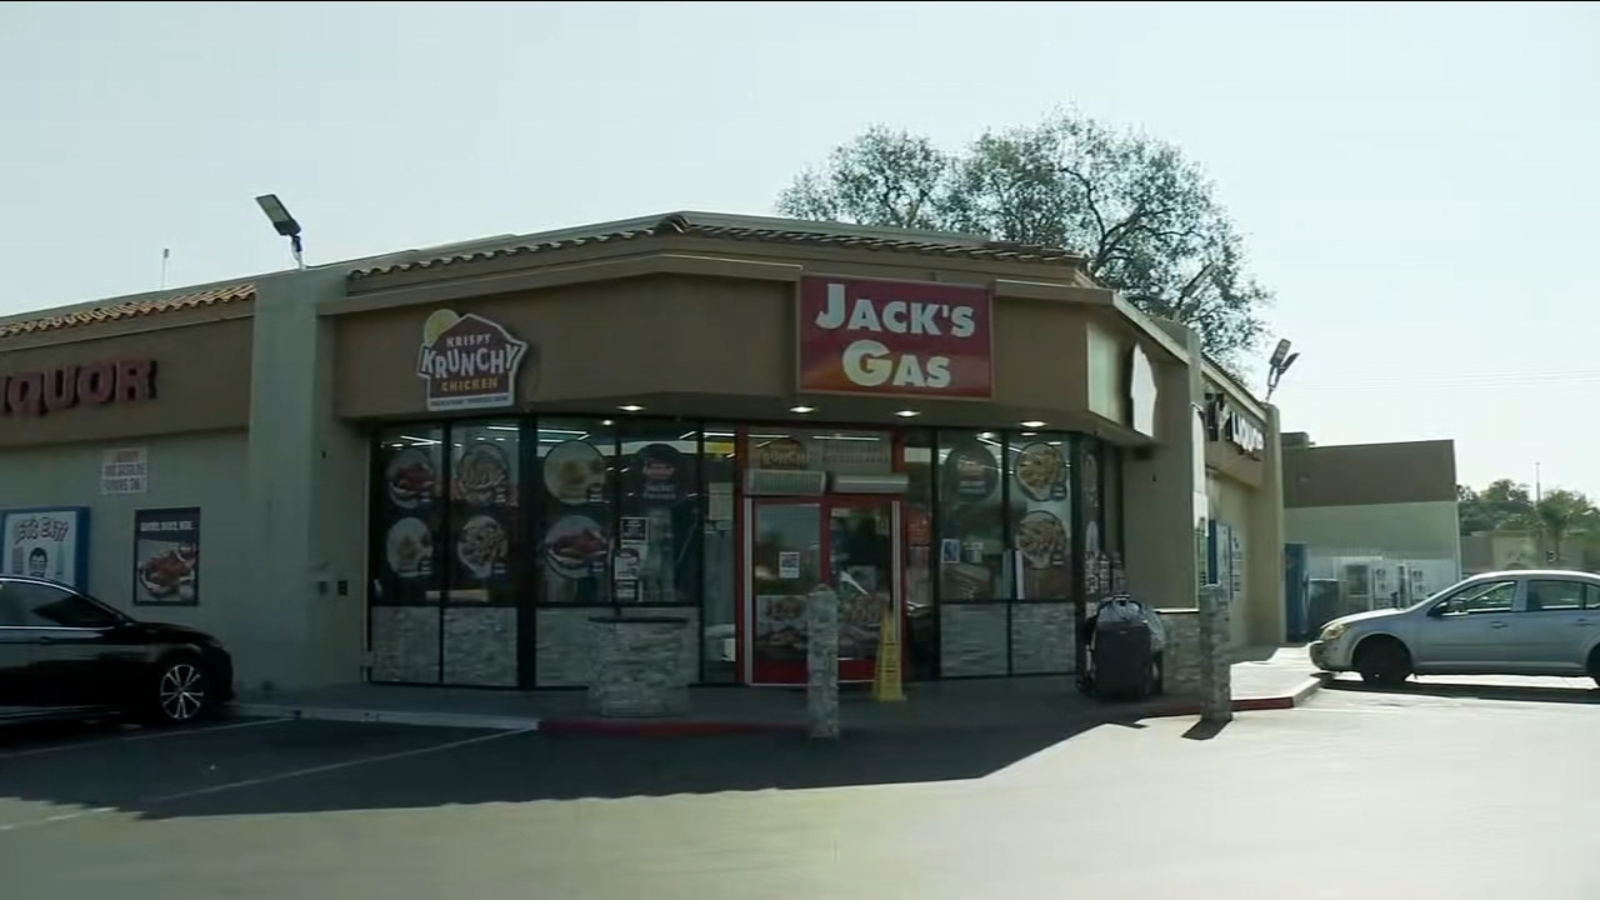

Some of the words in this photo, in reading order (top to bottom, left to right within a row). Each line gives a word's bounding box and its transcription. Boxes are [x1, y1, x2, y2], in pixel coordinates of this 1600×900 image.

[815, 283, 976, 338] JACK'S
[446, 333, 492, 348] KRISPY
[422, 344, 520, 379] KRUNCHY
[842, 339, 951, 388] GAS
[441, 377, 499, 392] CHICKEN
